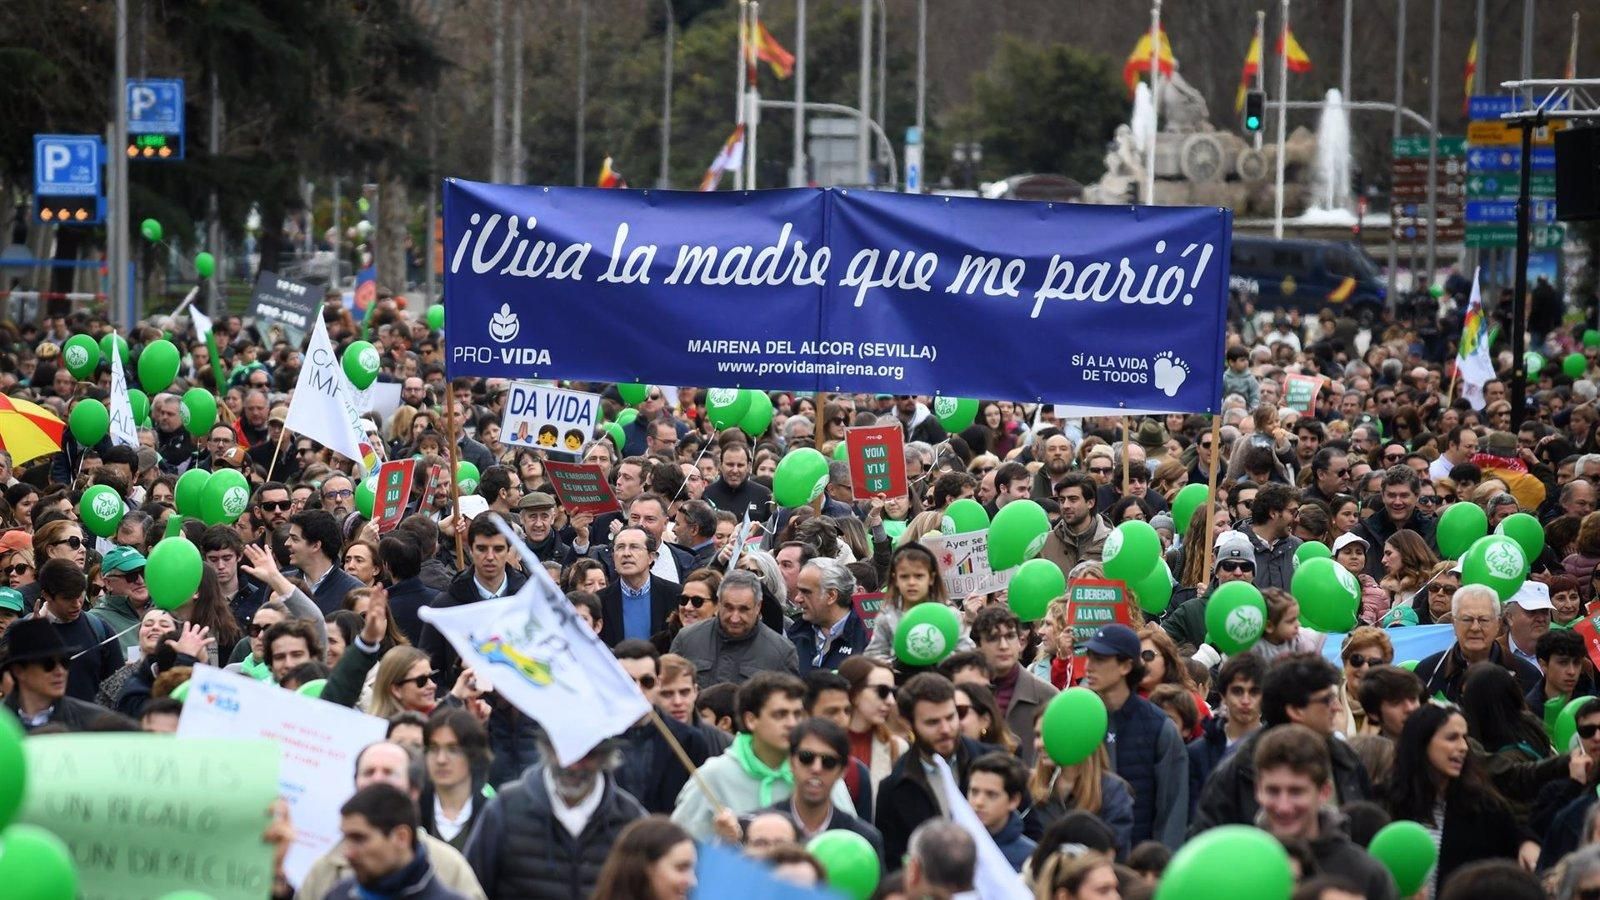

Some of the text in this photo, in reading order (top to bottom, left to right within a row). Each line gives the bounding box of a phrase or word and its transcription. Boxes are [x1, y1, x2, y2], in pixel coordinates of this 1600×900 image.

[131, 87, 156, 120] P
[45, 145, 71, 181] P
[451, 213, 1214, 318] ¡Viva la madre que me parió!
[454, 346, 552, 365] PRO-VIDA
[688, 340, 937, 361] MAIRENA DEL ALCOR (SEVILLA)
[1072, 353, 1148, 370] SÍ A LA VIDA
[718, 361, 904, 380] www.providamairena.org
[1082, 370, 1148, 384] DE TODOS
[510, 388, 591, 426] DA VIDA
[864, 446, 886, 459] VIDA
[555, 471, 597, 480] EL EMBRIÓN
[867, 463, 886, 475] A LA
[562, 482, 598, 492] ES UN SER
[874, 479, 883, 491] SÍ
[392, 491, 399, 501] LA
[570, 494, 601, 503] HUMANO
[946, 537, 983, 550] Ayer se
[1076, 588, 1116, 600] EL DERECHO
[862, 601, 872, 611] LA
[1077, 608, 1113, 620] A LA VIDA
